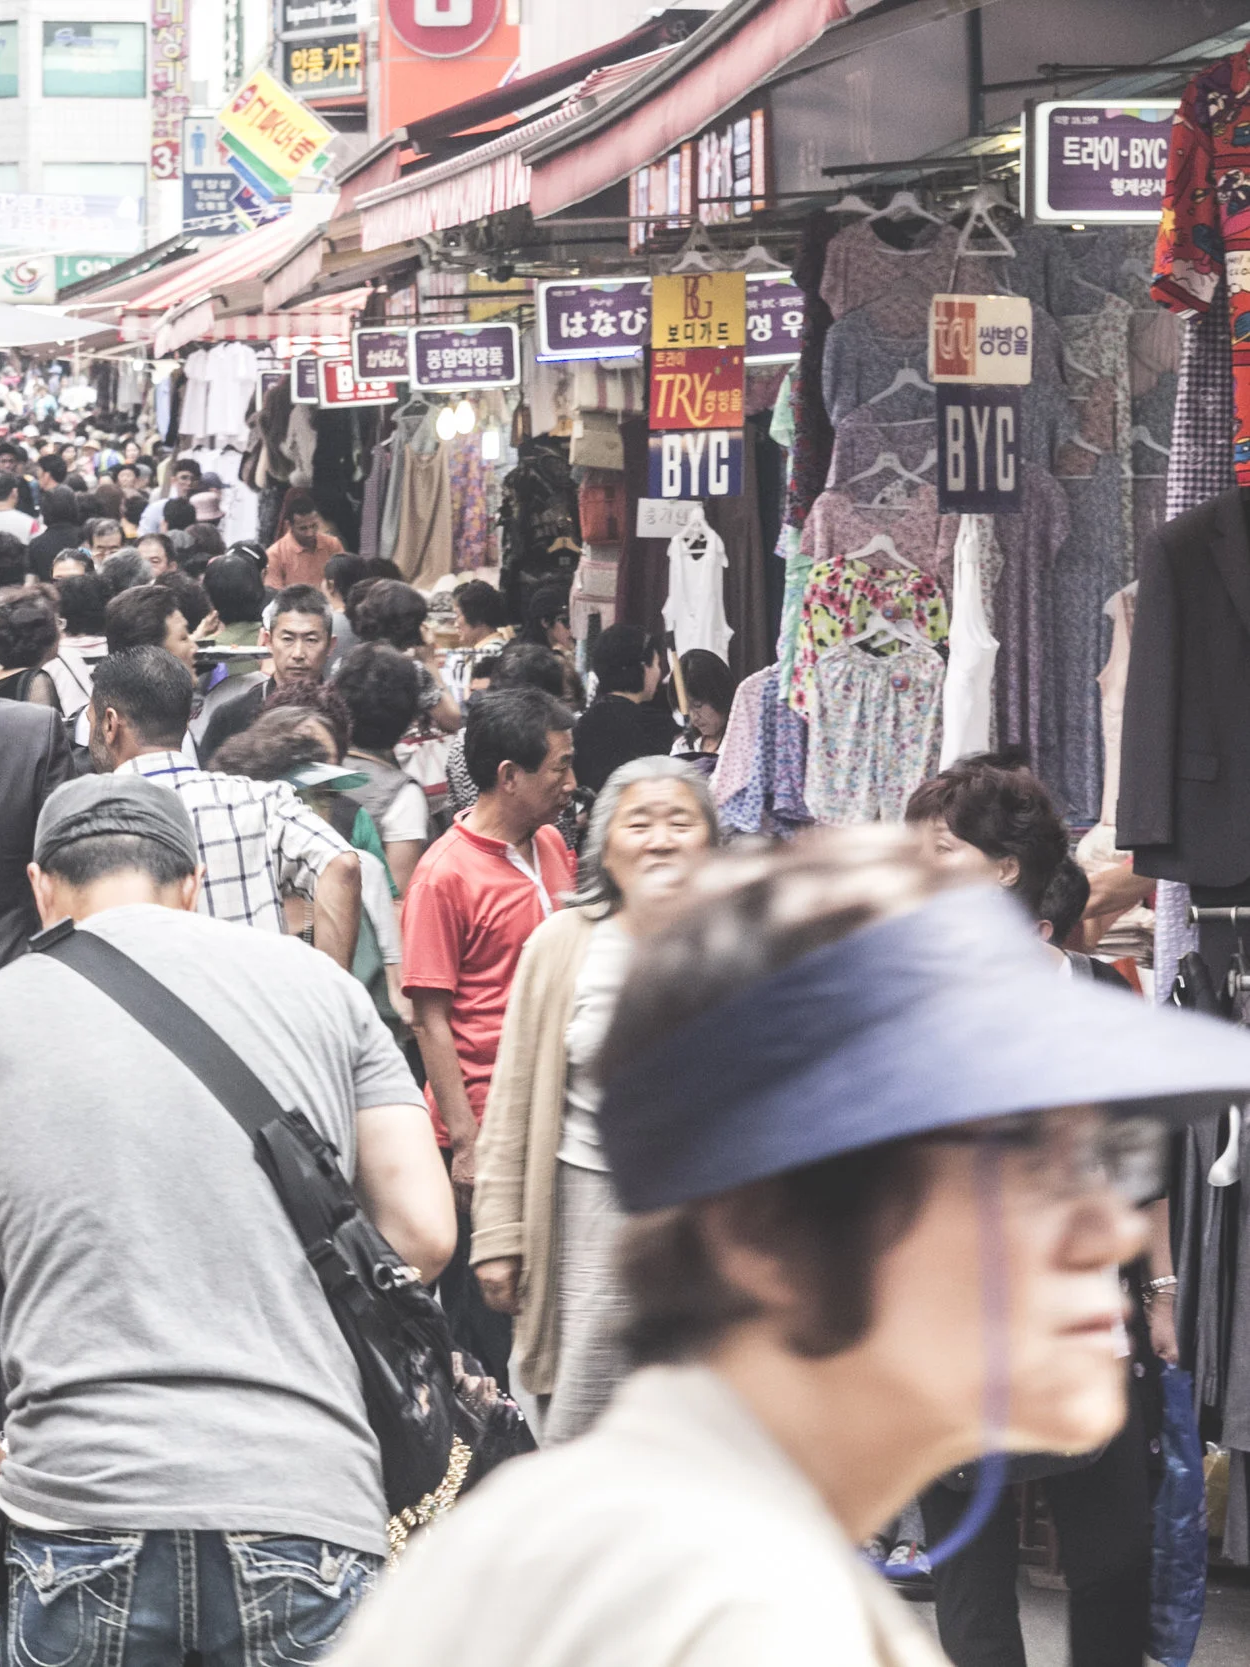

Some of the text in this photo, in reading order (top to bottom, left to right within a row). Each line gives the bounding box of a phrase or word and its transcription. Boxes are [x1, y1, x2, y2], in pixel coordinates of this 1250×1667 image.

[1062, 136, 1167, 171] 트라이·BYC
[560, 307, 648, 338] はなび
[668, 321, 729, 344] 보디가드
[979, 326, 1029, 356] 쌍방울
[654, 352, 686, 367] 트라이
[654, 373, 712, 427] TRY
[661, 432, 729, 497] BYC
[946, 405, 1015, 491] BYC
